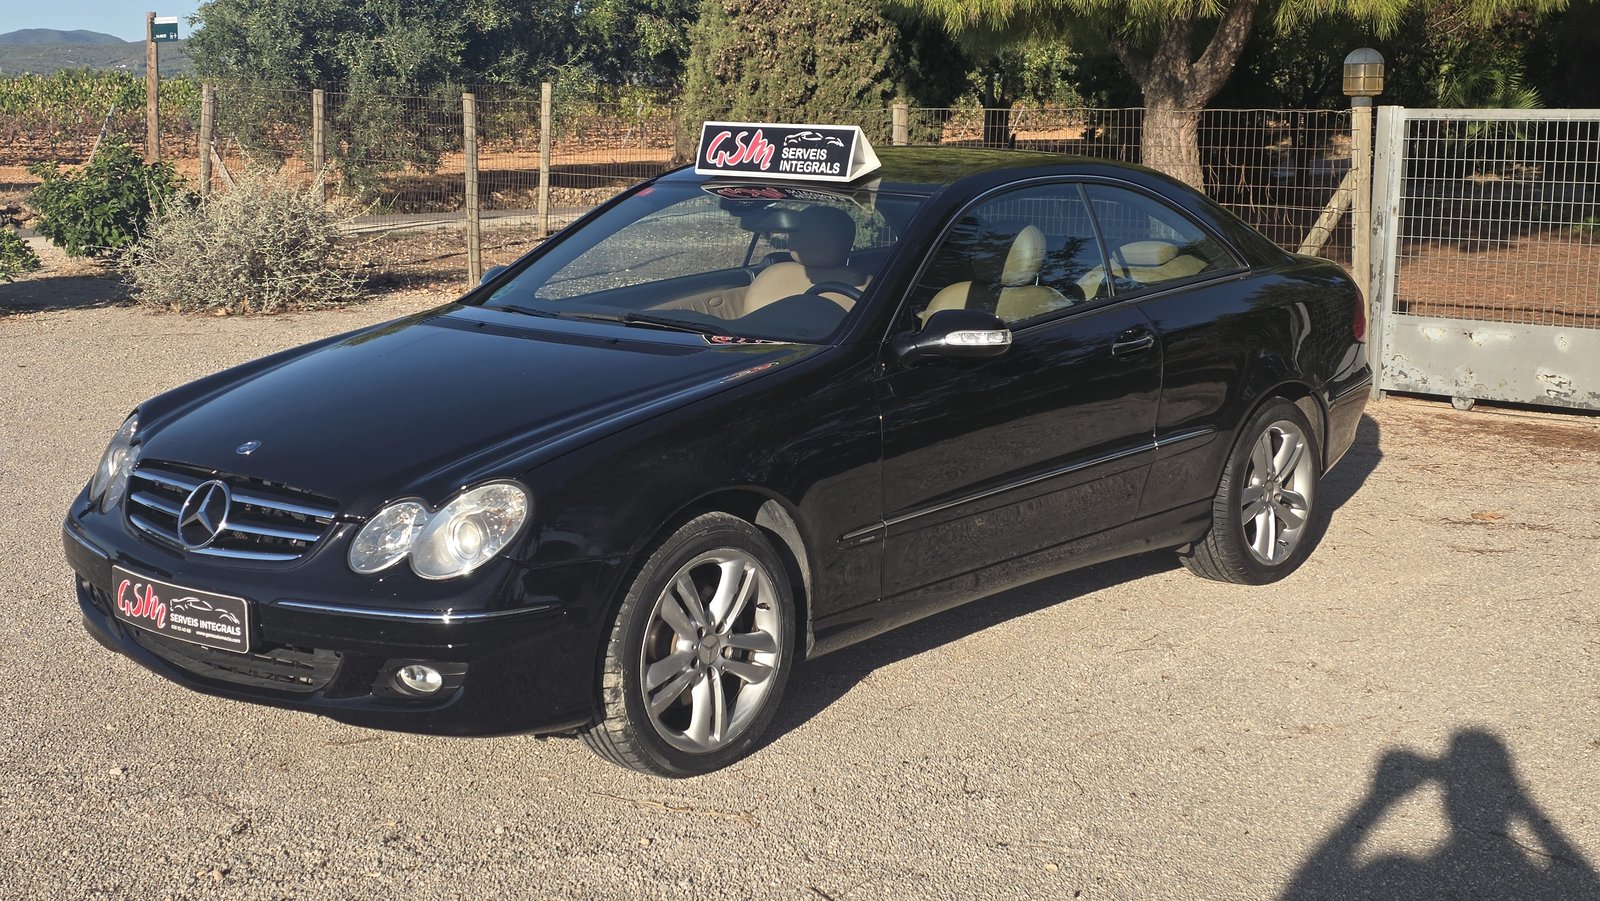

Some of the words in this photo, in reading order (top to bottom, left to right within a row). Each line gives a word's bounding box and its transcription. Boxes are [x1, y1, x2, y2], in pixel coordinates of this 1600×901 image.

[782, 148, 827, 160] SERVEIS
[779, 160, 840, 174] INTEGRALS
[170, 613, 198, 628] SERVEIS
[200, 620, 241, 636] INTEGRALS
